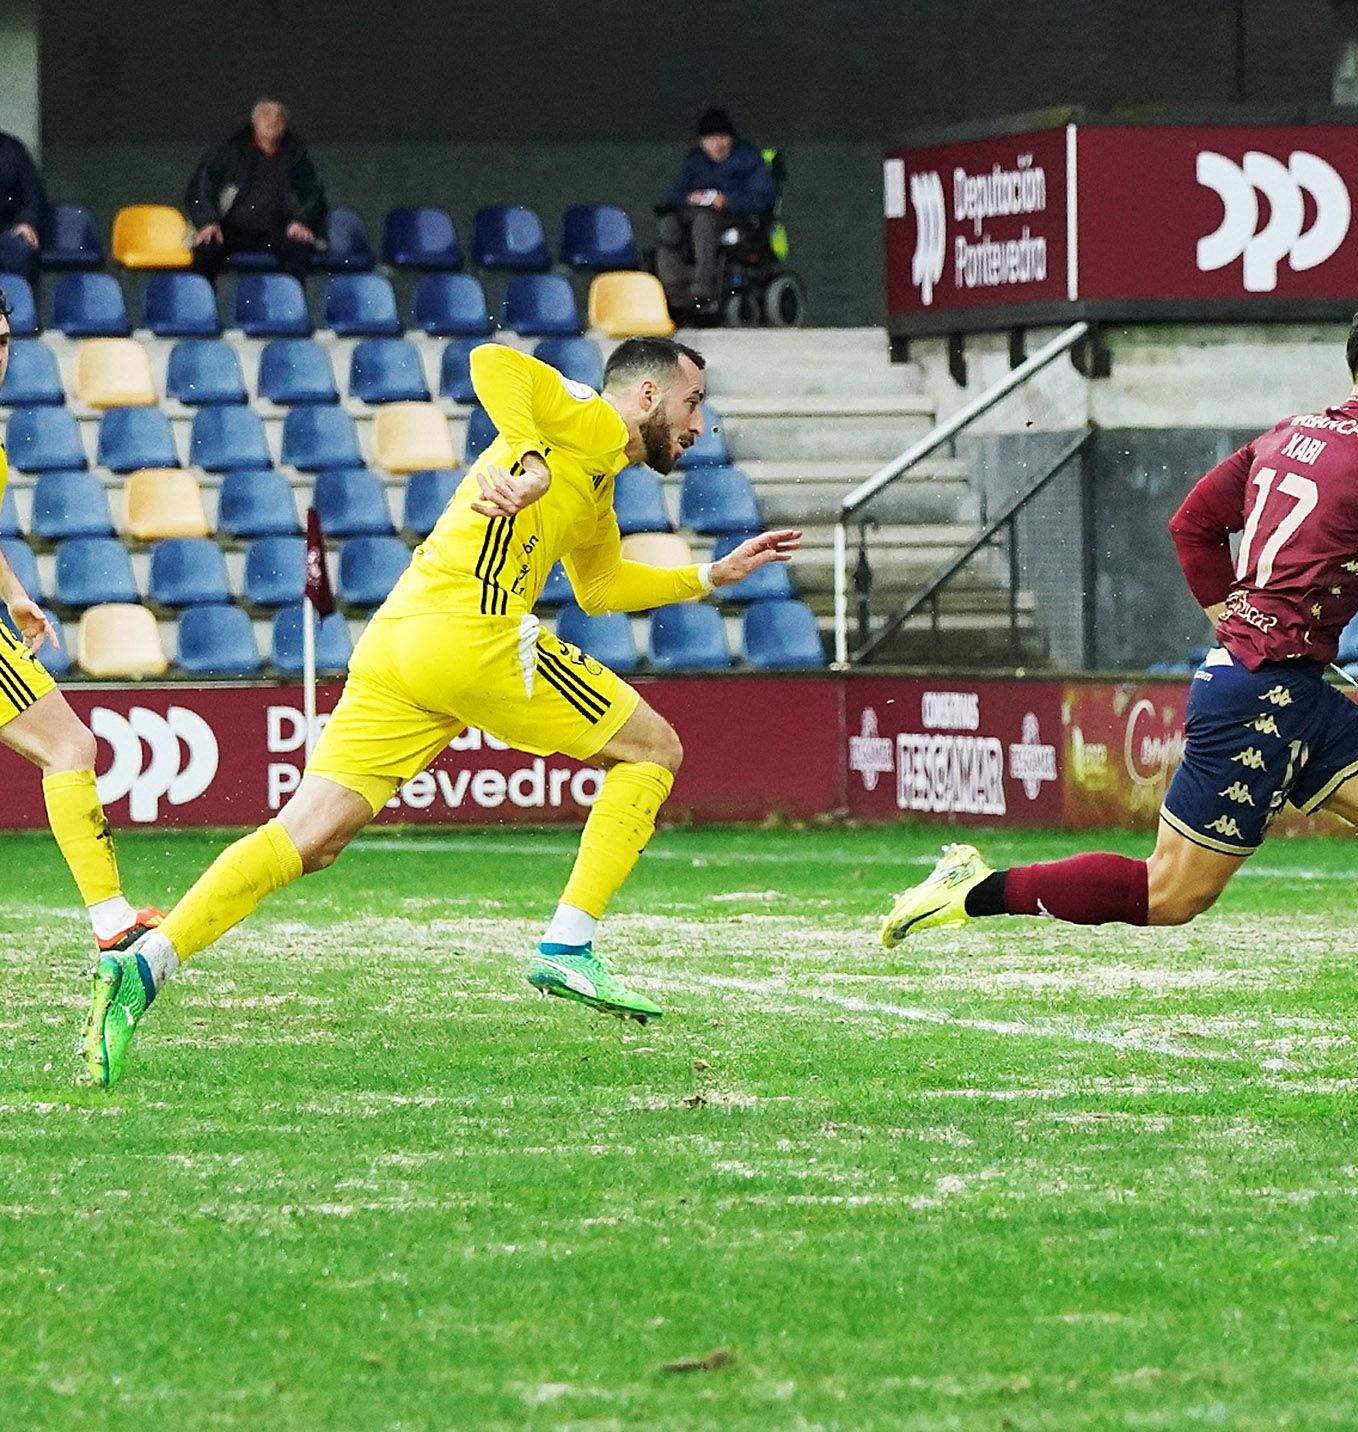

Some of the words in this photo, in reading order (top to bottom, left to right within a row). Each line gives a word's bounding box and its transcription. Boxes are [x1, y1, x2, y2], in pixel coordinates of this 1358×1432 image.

[953, 153, 1046, 236] Deputación
[954, 225, 1047, 289] Pontevedra
[1281, 432, 1327, 465] XABI
[1236, 466, 1319, 589] 17
